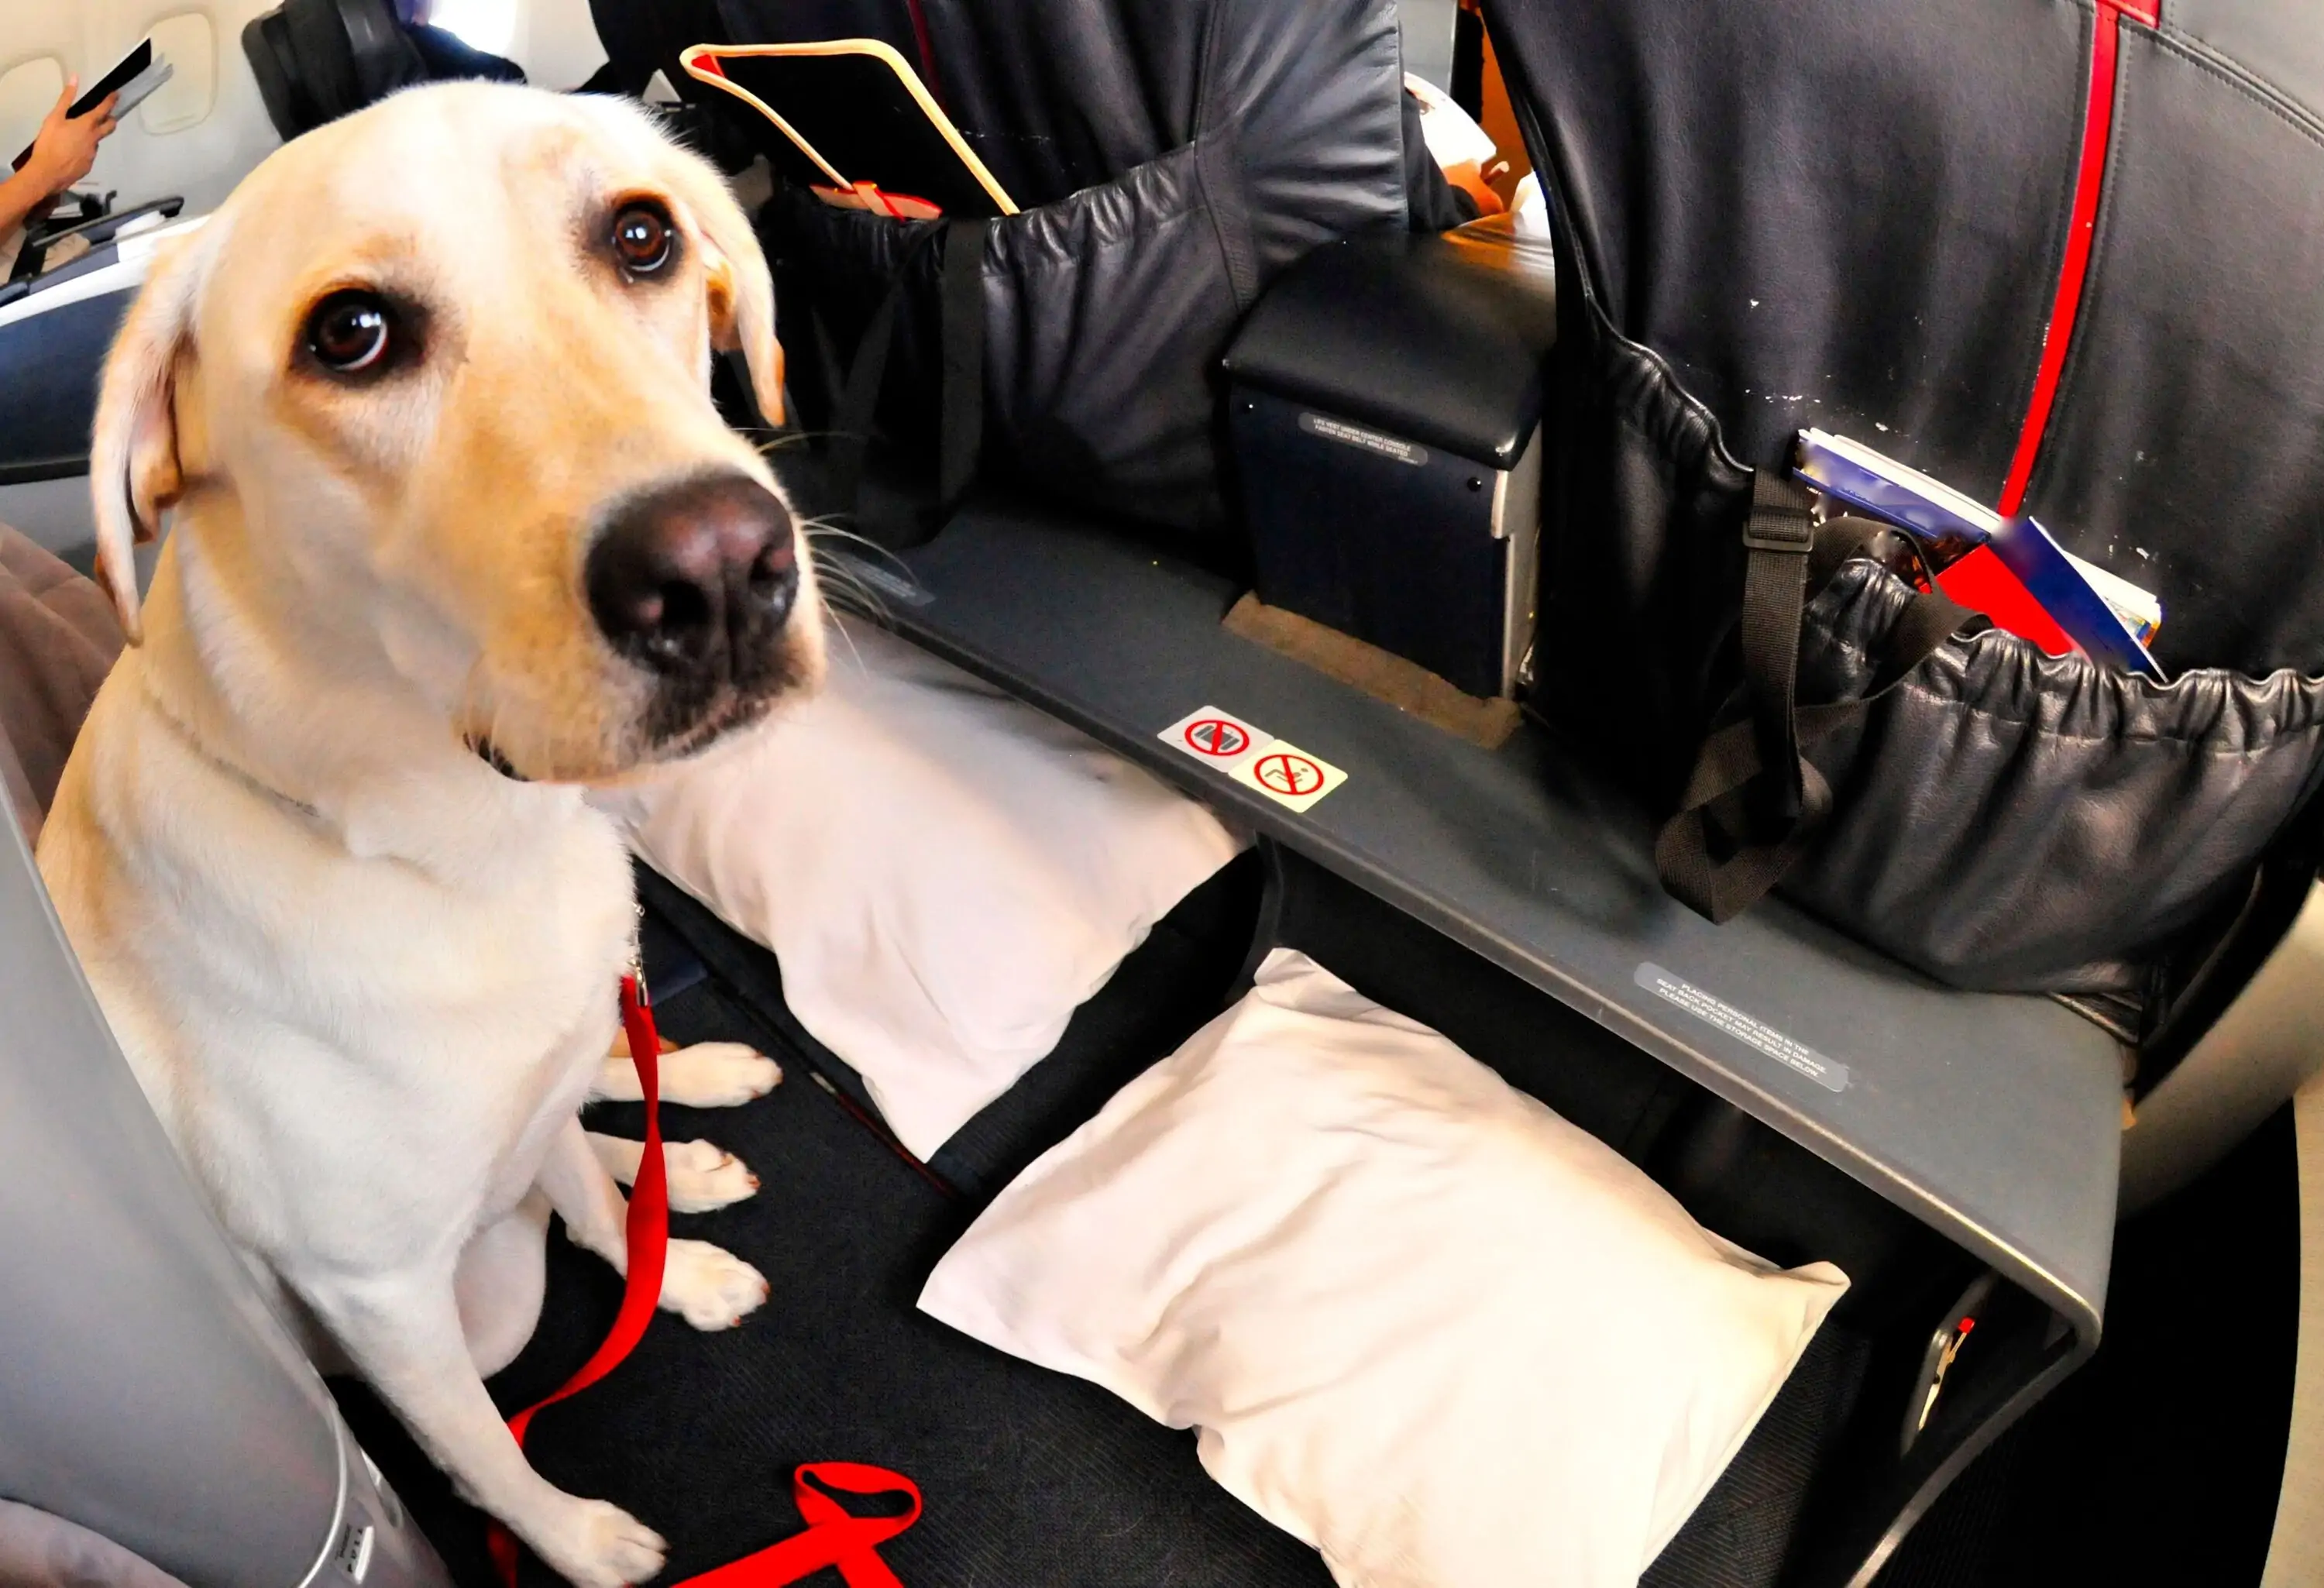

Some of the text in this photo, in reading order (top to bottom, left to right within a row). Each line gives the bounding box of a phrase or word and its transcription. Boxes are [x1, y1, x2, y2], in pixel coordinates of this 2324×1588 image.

[1384, 438, 1411, 451] CONSOLE
[1656, 978, 1676, 992] SEAT
[1678, 990, 1700, 1004] BACK
[1701, 1002, 1732, 1021] POCKET
[1734, 1020, 1752, 1032] MAY
[1752, 1030, 1781, 1048] RESULT
[1659, 988, 1690, 1007] PLEASE
[1691, 1005, 1708, 1016] USE
[1710, 1014, 1724, 1026] THE
[1725, 1023, 1762, 1047] STORAGE
[1764, 1045, 1789, 1061] SPACE
[1682, 984, 1716, 1005] PLACING
[1717, 1003, 1757, 1028] PERSONAL
[1759, 1026, 1783, 1042] ITEMS
[1795, 1044, 1809, 1054] THE
